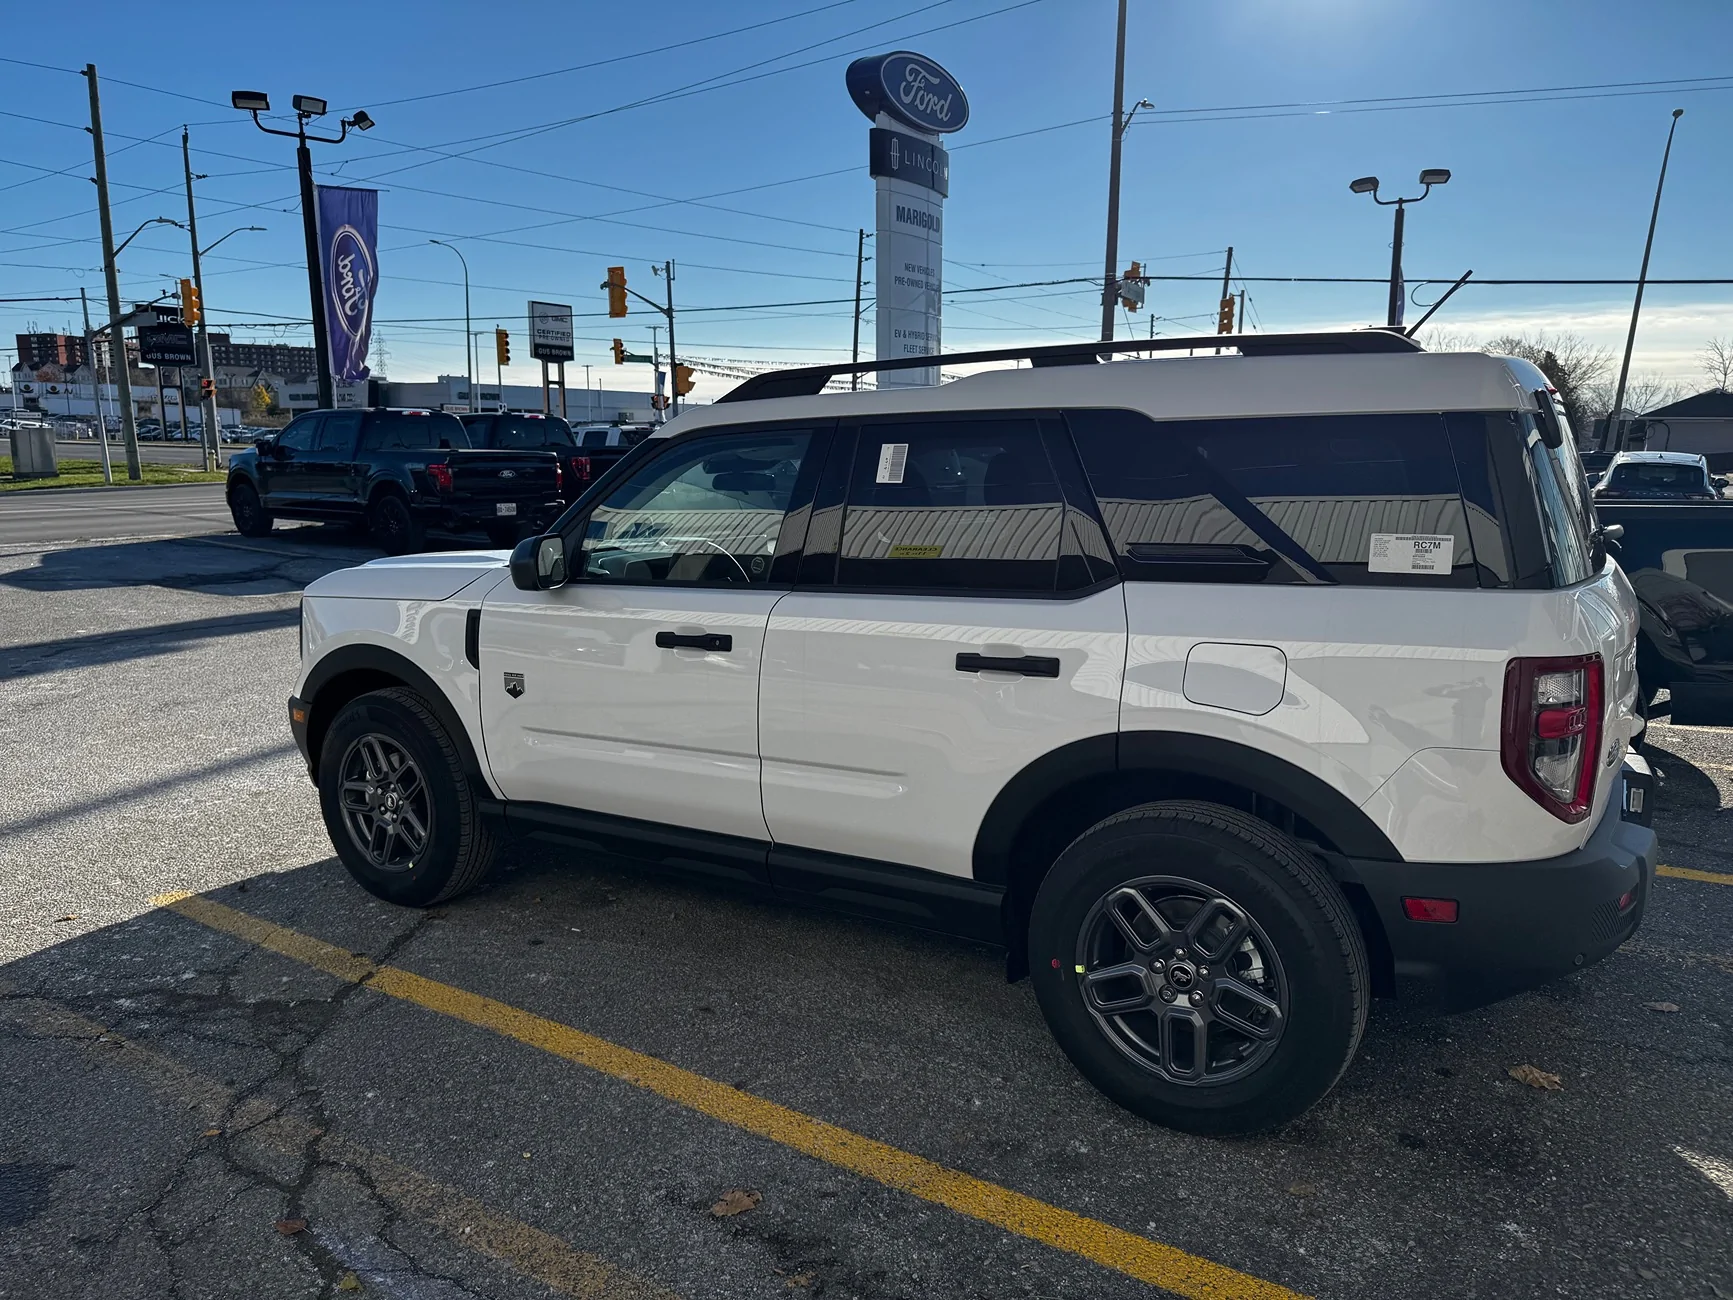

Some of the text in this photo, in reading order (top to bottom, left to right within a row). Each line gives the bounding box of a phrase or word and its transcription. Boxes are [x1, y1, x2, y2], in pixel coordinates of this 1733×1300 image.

[899, 63, 952, 122] Ford
[904, 149, 948, 180] LINCOLN
[896, 205, 940, 233] MARIGOLD
[904, 262, 935, 277] NEW VEHICLES
[894, 276, 923, 289] PRE-OWNED
[537, 329, 571, 337] CERTIFIED
[894, 329, 902, 338] EV
[902, 330, 907, 339] &
[903, 344, 918, 353] FLEET
[1413, 541, 1441, 549] RC7M
